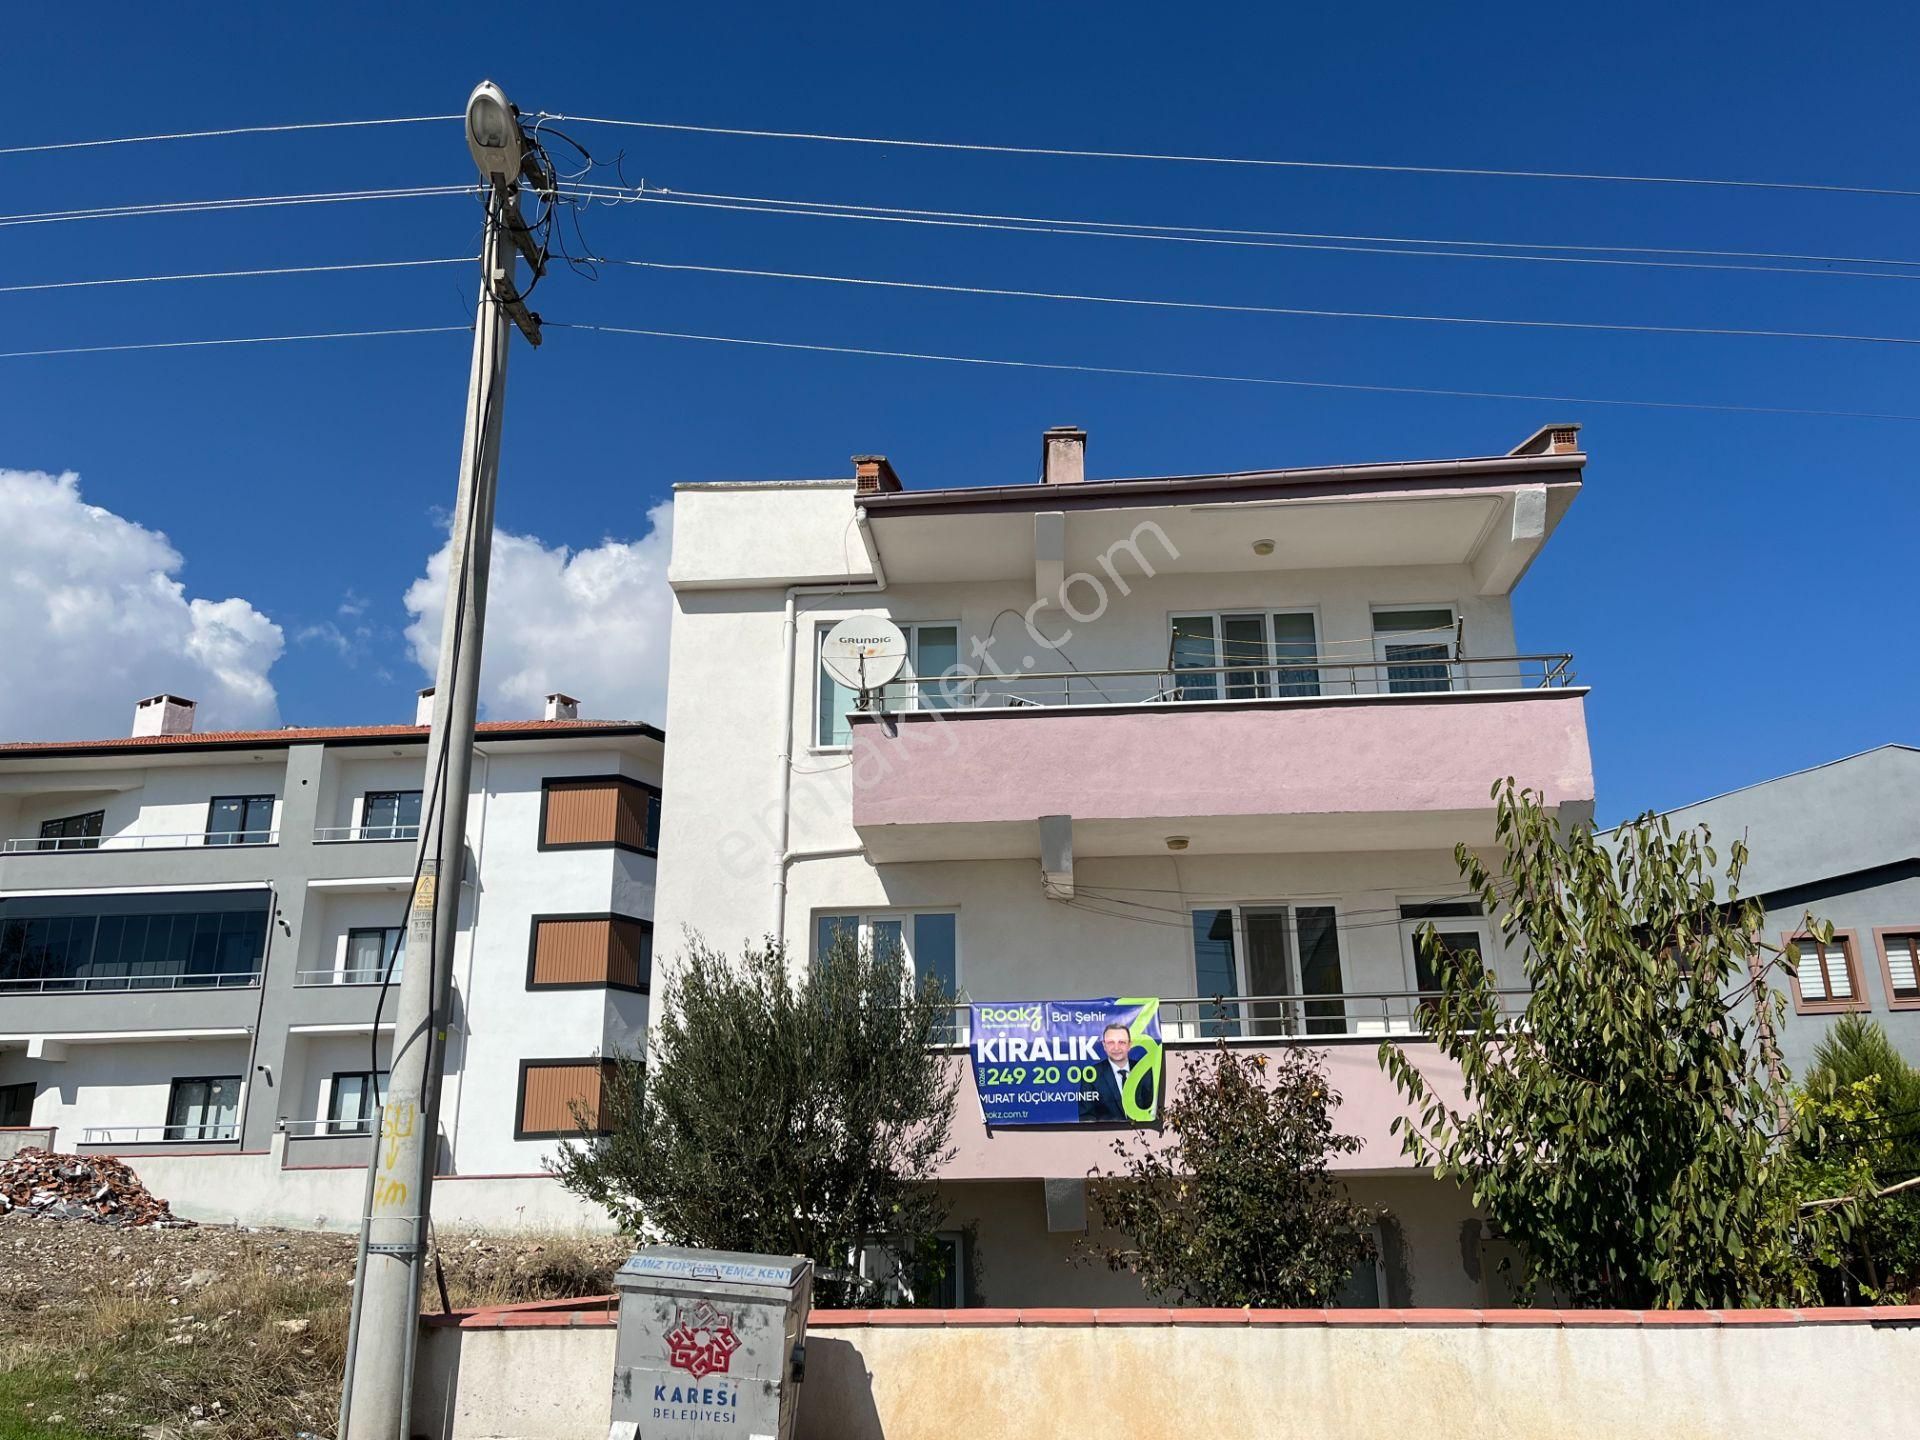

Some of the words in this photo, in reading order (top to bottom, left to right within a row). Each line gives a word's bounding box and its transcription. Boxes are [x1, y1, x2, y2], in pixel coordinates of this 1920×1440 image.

[839, 636, 892, 644] GRUNDIG
[981, 1005, 1043, 1032] Rookz
[1051, 1011, 1072, 1022] Bal
[1075, 1011, 1106, 1025] Şehir
[977, 1031, 1101, 1063] KİRALIK
[987, 1067, 1027, 1085] 249
[1032, 1066, 1061, 1084] 20
[1066, 1065, 1097, 1083] 00
[979, 1093, 1015, 1104] MURAT
